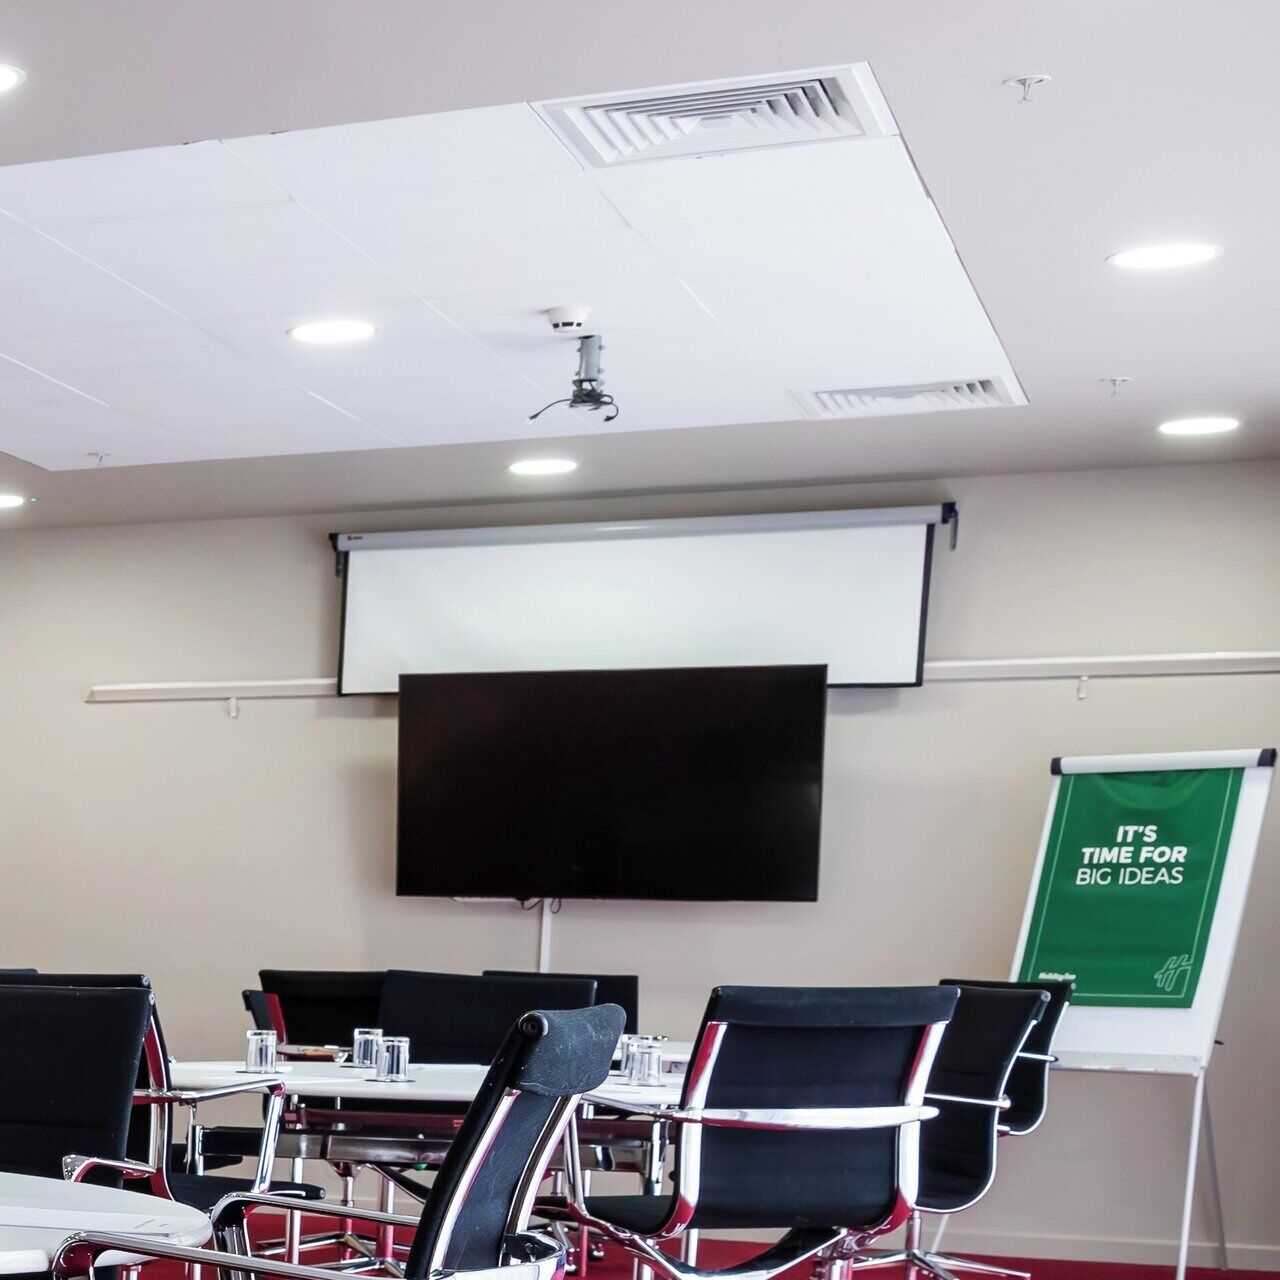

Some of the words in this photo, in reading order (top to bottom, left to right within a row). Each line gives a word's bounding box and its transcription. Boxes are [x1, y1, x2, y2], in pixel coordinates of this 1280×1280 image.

[1116, 825, 1158, 843] IT'S
[1081, 846, 1135, 864] TIME
[1139, 846, 1188, 863] FOR
[1075, 867, 1112, 885] BIG
[1118, 867, 1184, 885] IDEAS
